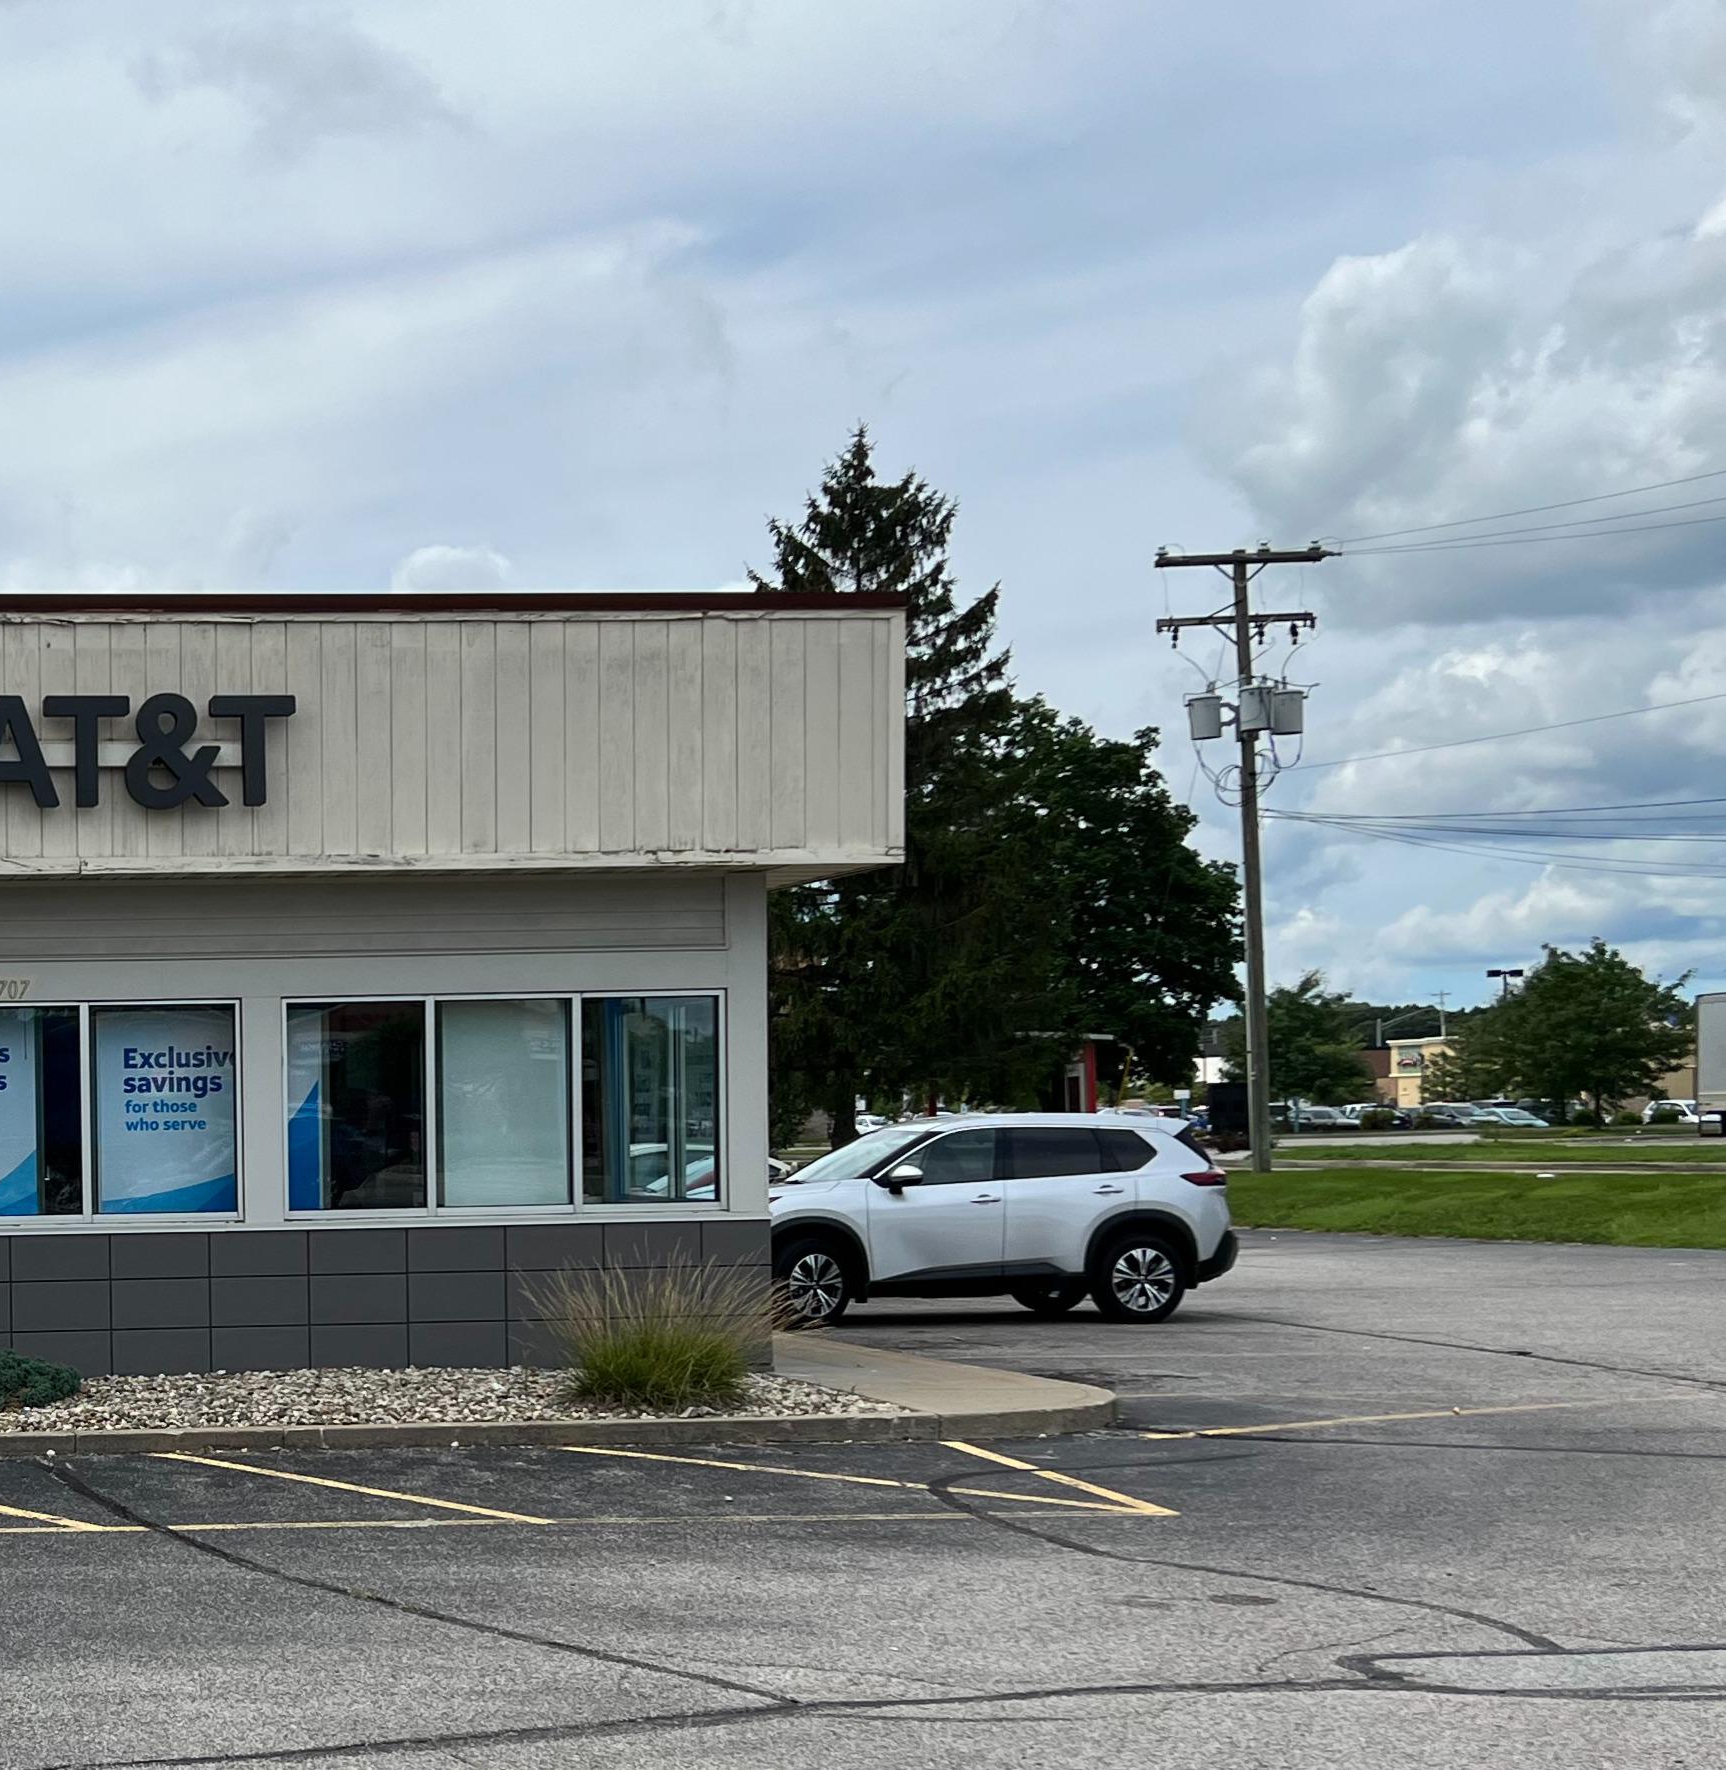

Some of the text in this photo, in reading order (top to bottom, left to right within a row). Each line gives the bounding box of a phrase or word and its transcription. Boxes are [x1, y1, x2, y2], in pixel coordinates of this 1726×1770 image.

[123, 1070, 223, 1099] savings
[125, 1099, 197, 1113] for those
[125, 1117, 207, 1131] who serve
